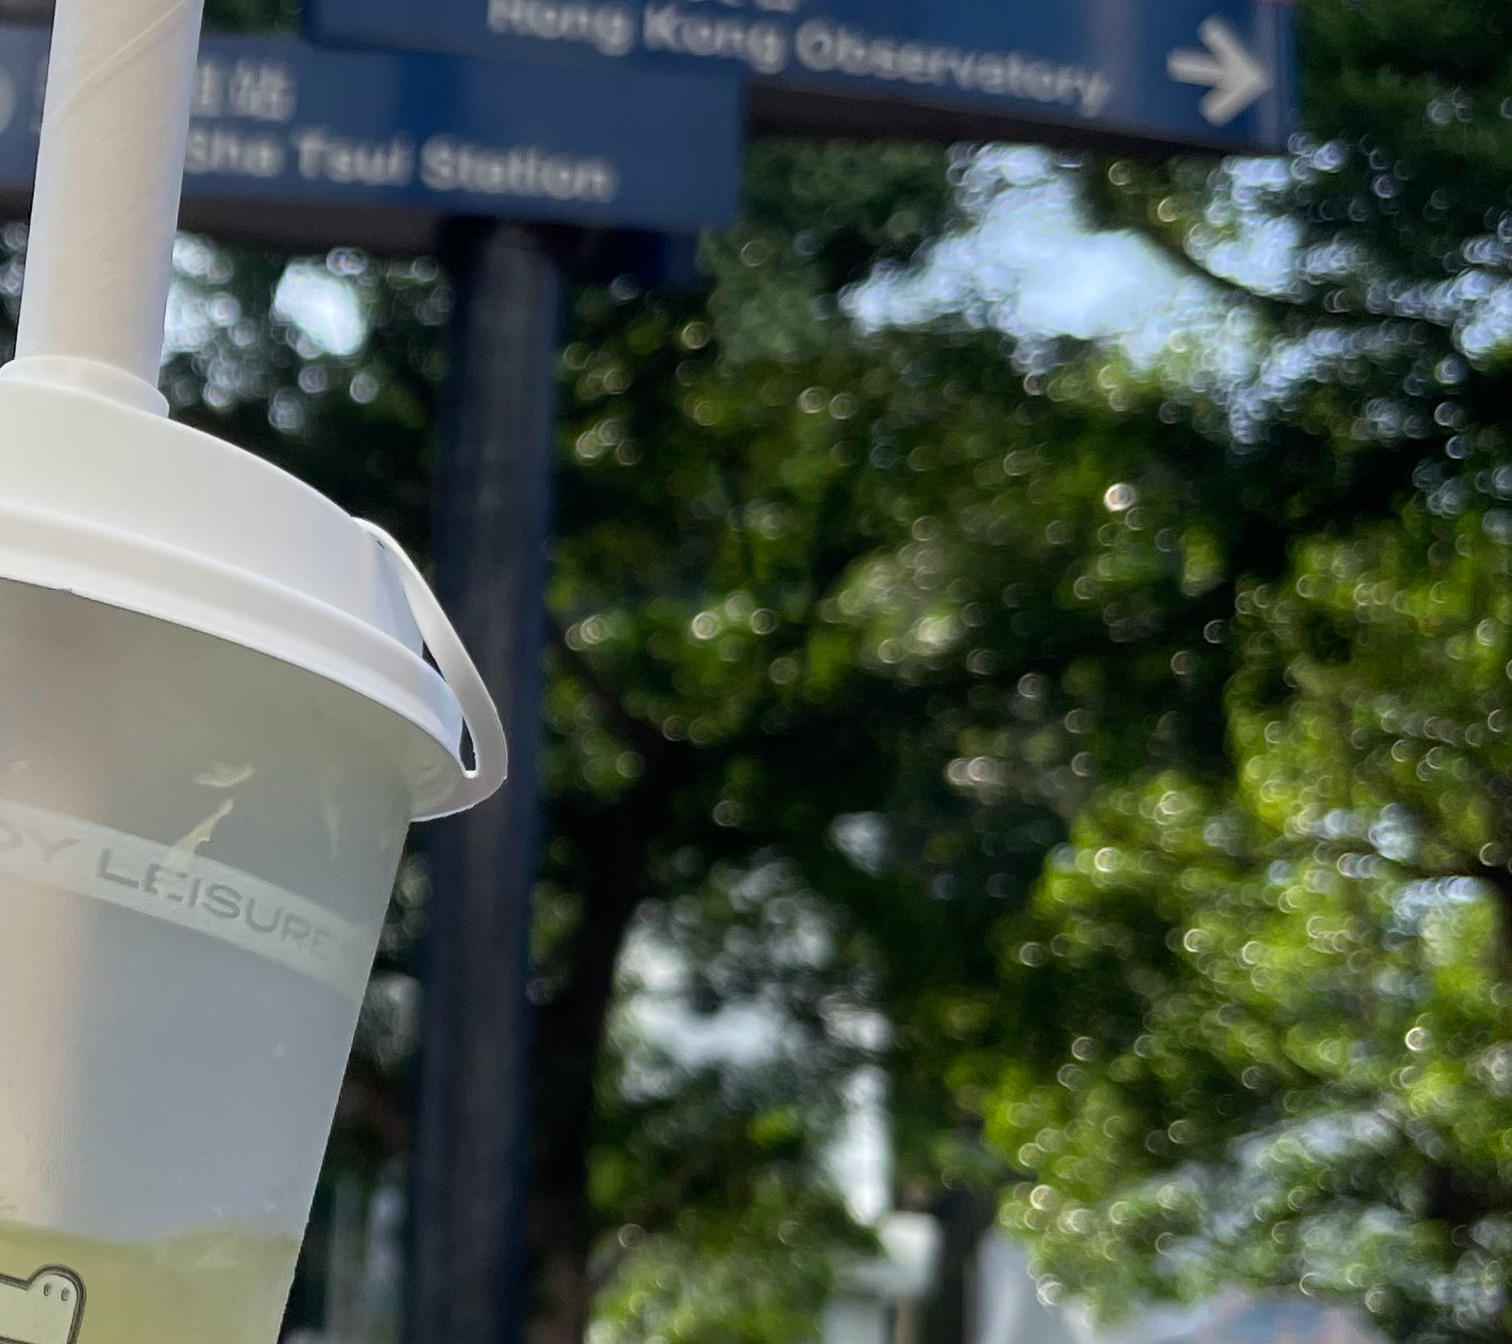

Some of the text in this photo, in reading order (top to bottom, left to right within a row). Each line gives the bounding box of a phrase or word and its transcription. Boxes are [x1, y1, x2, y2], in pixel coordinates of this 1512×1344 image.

[642, 0, 785, 75] Kong
[794, 17, 1113, 117] Observatory
[296, 124, 411, 188] Tsui
[420, 134, 617, 203] Station
